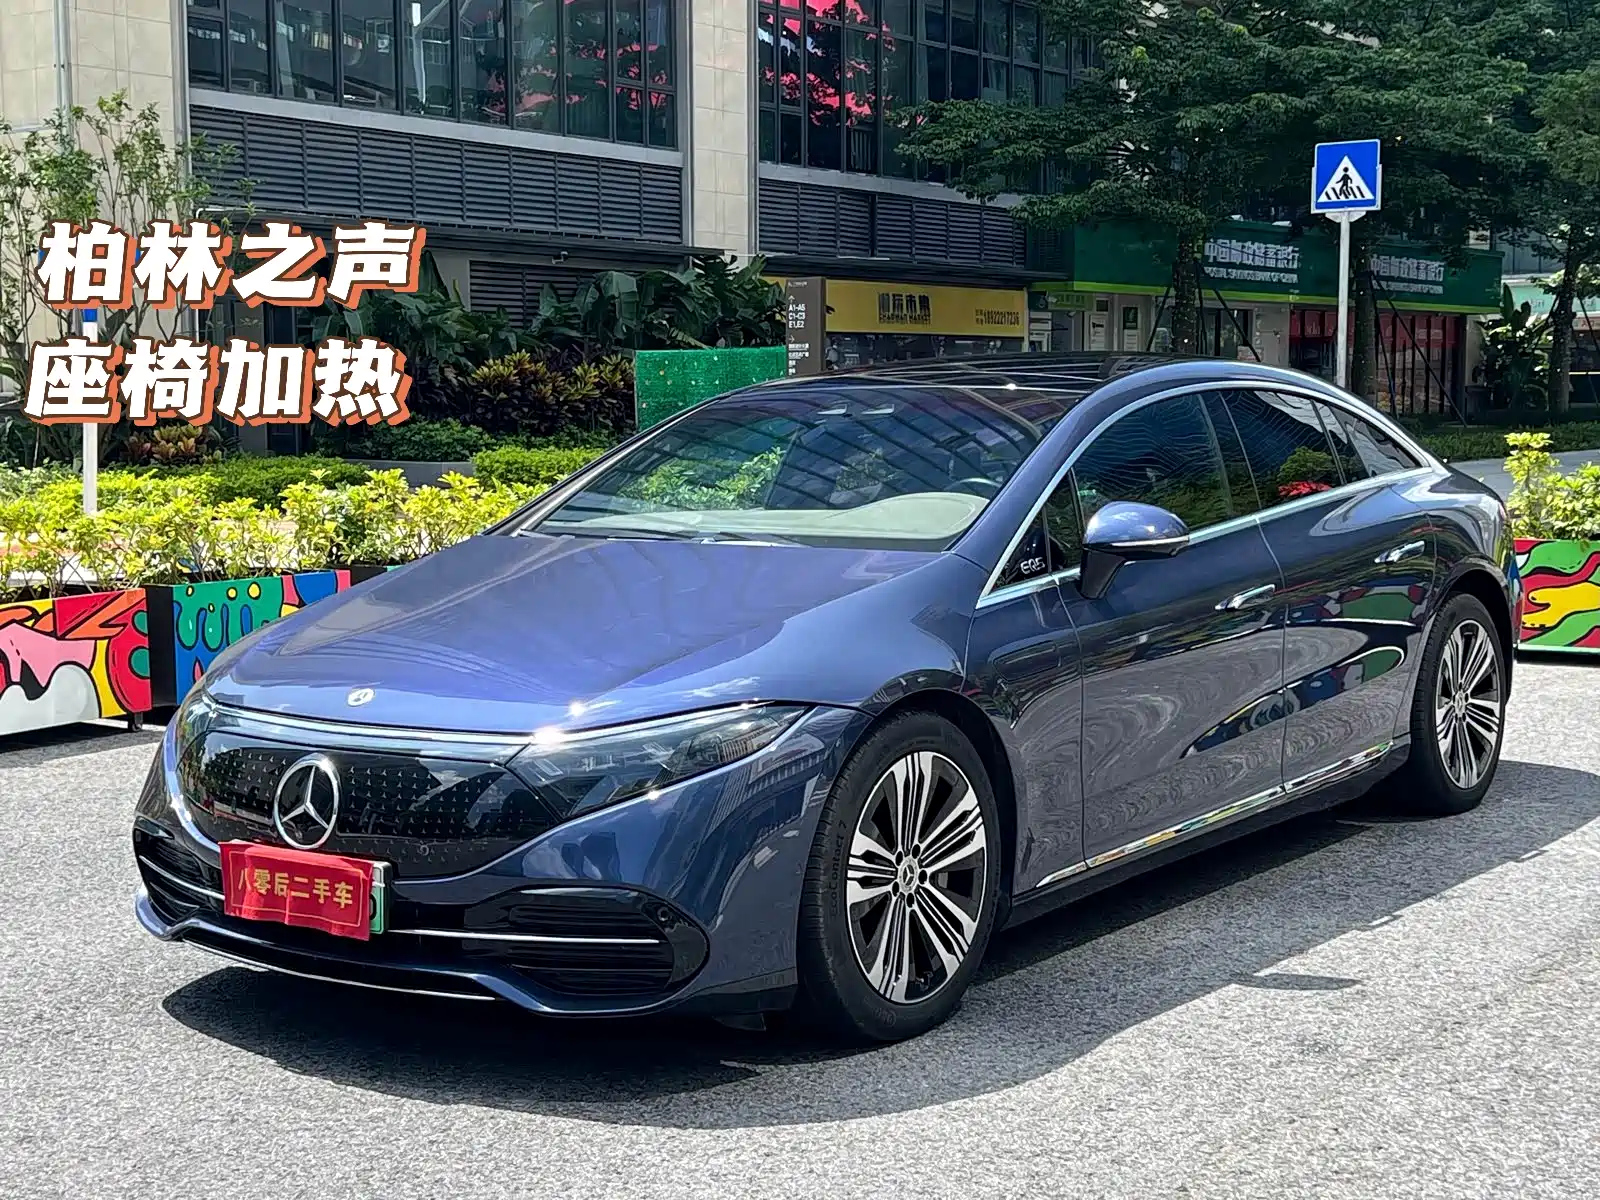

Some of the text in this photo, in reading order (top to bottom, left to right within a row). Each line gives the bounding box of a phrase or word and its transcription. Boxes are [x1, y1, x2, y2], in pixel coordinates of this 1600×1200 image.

[788, 303, 806, 312] A1-A5
[788, 312, 806, 320] C1-C3
[1020, 556, 1046, 575] EQS
[238, 867, 354, 910] 八零后二手车
